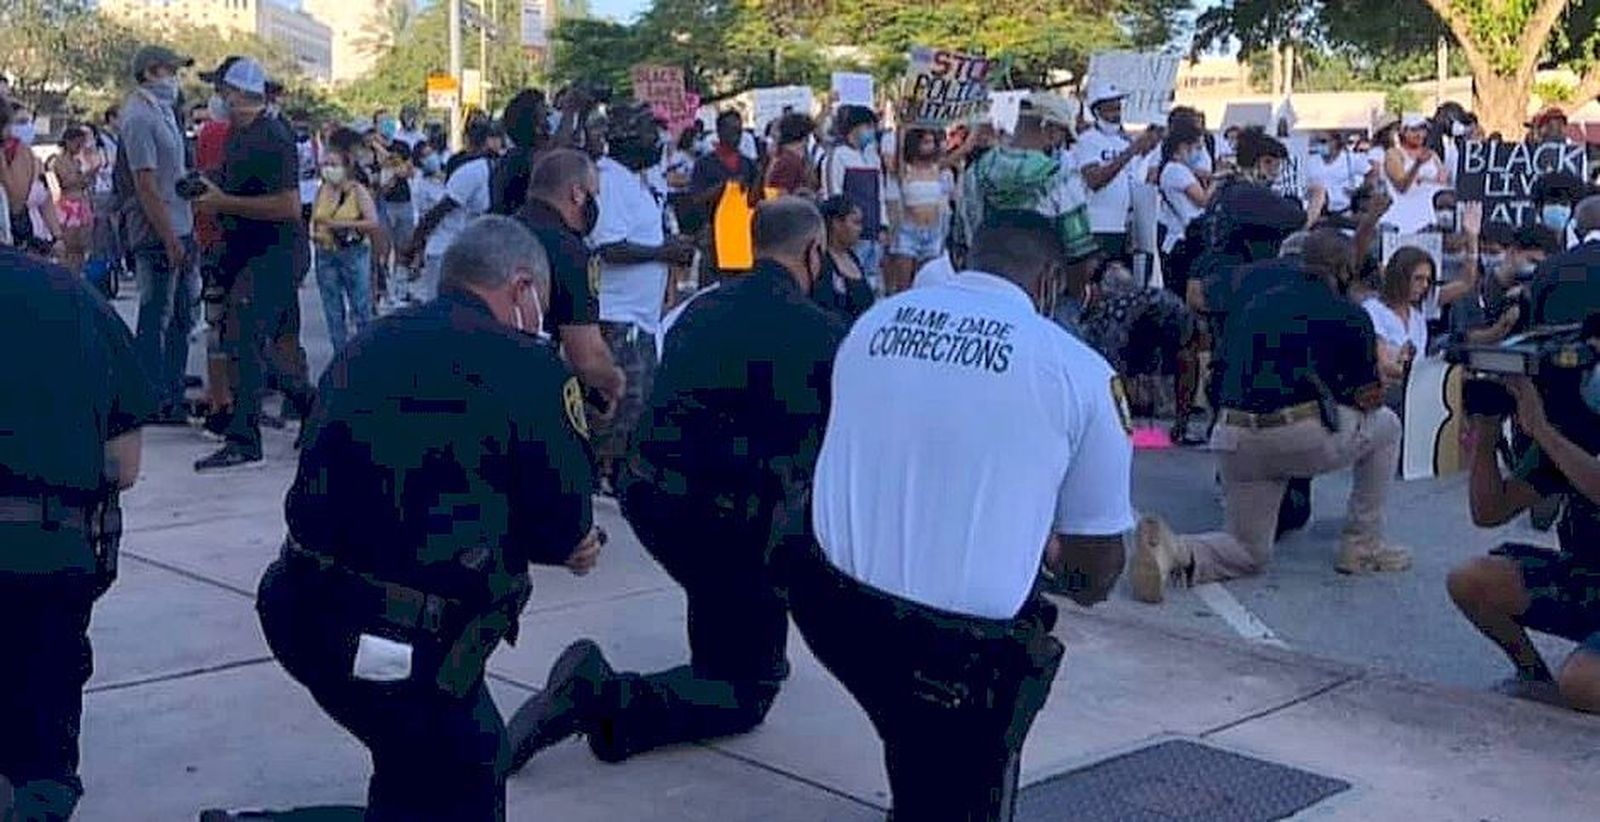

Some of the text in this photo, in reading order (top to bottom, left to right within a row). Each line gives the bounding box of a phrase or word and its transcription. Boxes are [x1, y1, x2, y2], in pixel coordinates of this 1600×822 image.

[1465, 140, 1586, 176] BLACK
[1484, 172, 1539, 197] LIV
[869, 325, 1014, 374] CORRECTIONS
